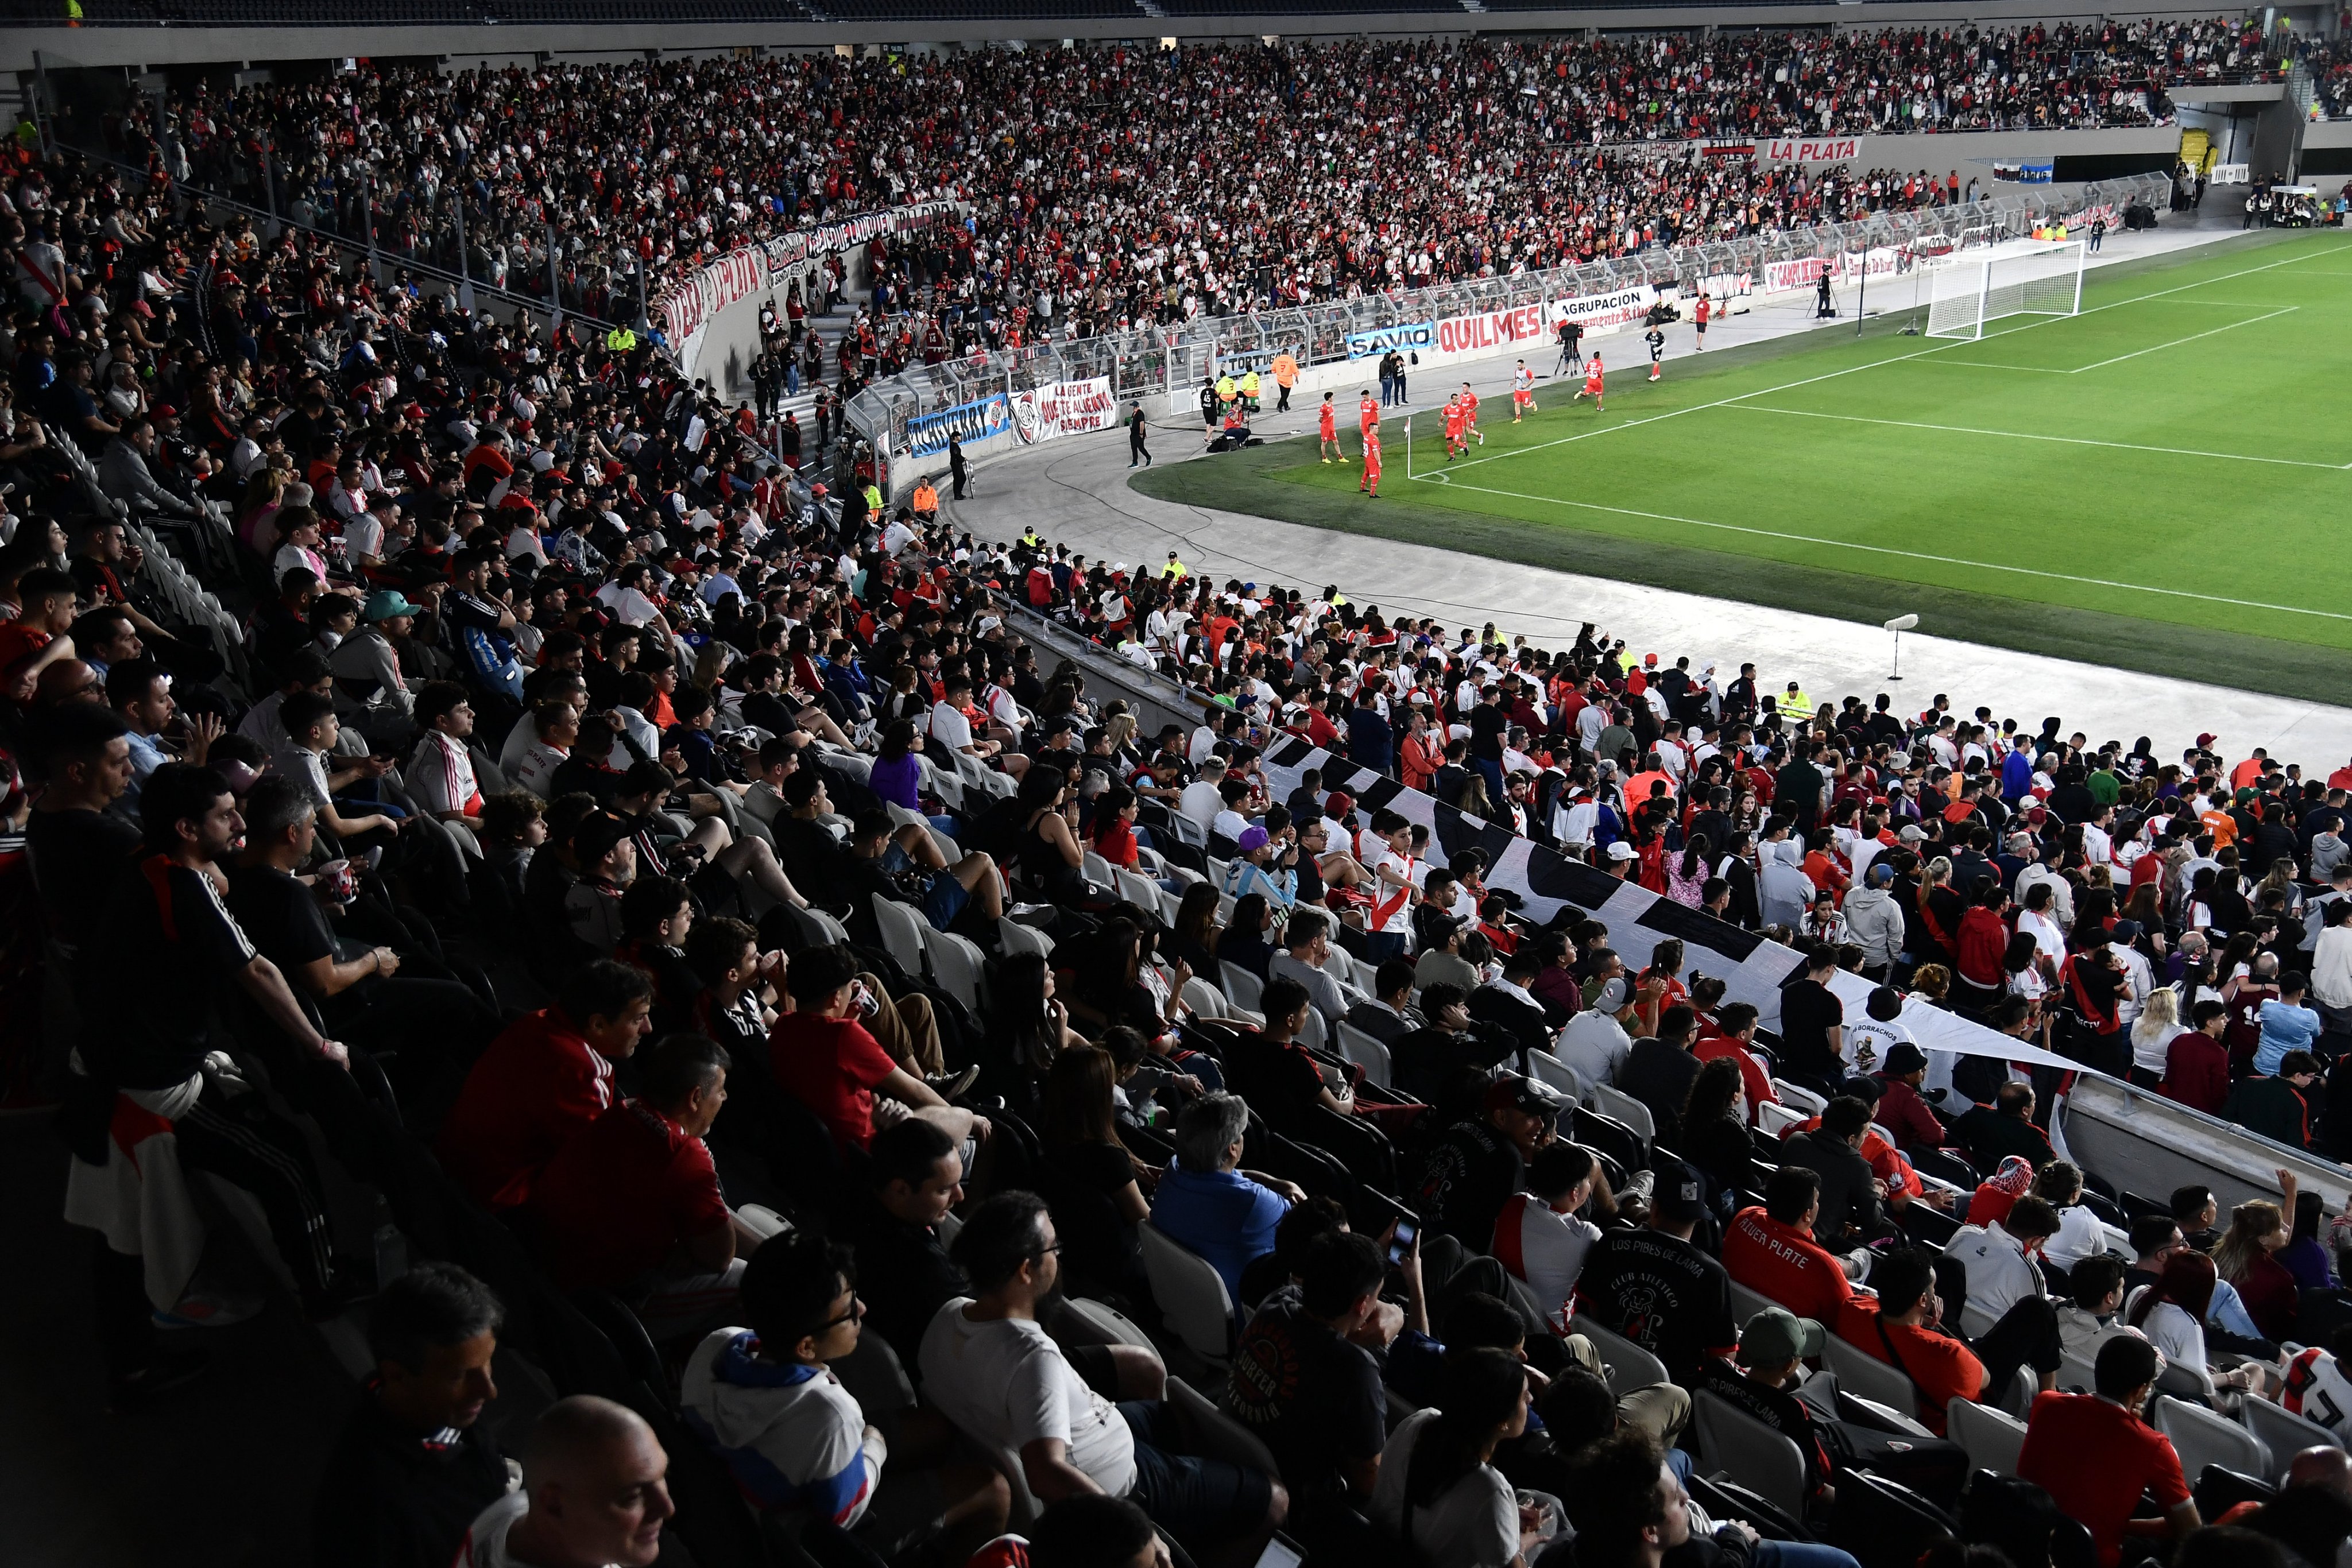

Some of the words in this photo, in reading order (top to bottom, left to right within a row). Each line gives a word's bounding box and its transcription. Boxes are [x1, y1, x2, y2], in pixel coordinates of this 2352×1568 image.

[1770, 141, 1792, 160] LA
[1798, 140, 1854, 160] PLATA
[719, 250, 760, 302] PLATA
[1778, 262, 1801, 287] CAMPO
[1801, 260, 1809, 281] DE
[1848, 258, 1871, 277] Amios
[1562, 292, 1641, 315] AGRUPACIÓN
[1352, 329, 1429, 355] SAVIO
[1440, 307, 1541, 353] QUILMES
[1055, 384, 1066, 397] LA
[1067, 382, 1092, 397] GENTE
[1204, 394, 1211, 402] 45
[1041, 401, 1059, 424] QUE
[1059, 400, 1072, 415] TE
[1073, 392, 1113, 414] ALIENTA
[909, 402, 988, 454] ETCHEVERRY
[1060, 415, 1101, 431] SIEMPRE
[2207, 827, 2214, 836] 1
[1858, 1024, 1897, 1042] BORRACHOS
[1738, 1217, 1767, 1246] RIVER
[1768, 1239, 1809, 1270] PLATE
[1612, 1239, 1631, 1251] LOS
[1633, 1240, 1662, 1257] PIBES
[1662, 1248, 1677, 1261] DE
[1676, 1254, 1704, 1279] LAMA
[1611, 1272, 1635, 1290] CLUB
[1638, 1272, 1678, 1308] ATLETICO
[1238, 1349, 1278, 1398] SURFER
[1755, 1401, 1782, 1430] LAMA
